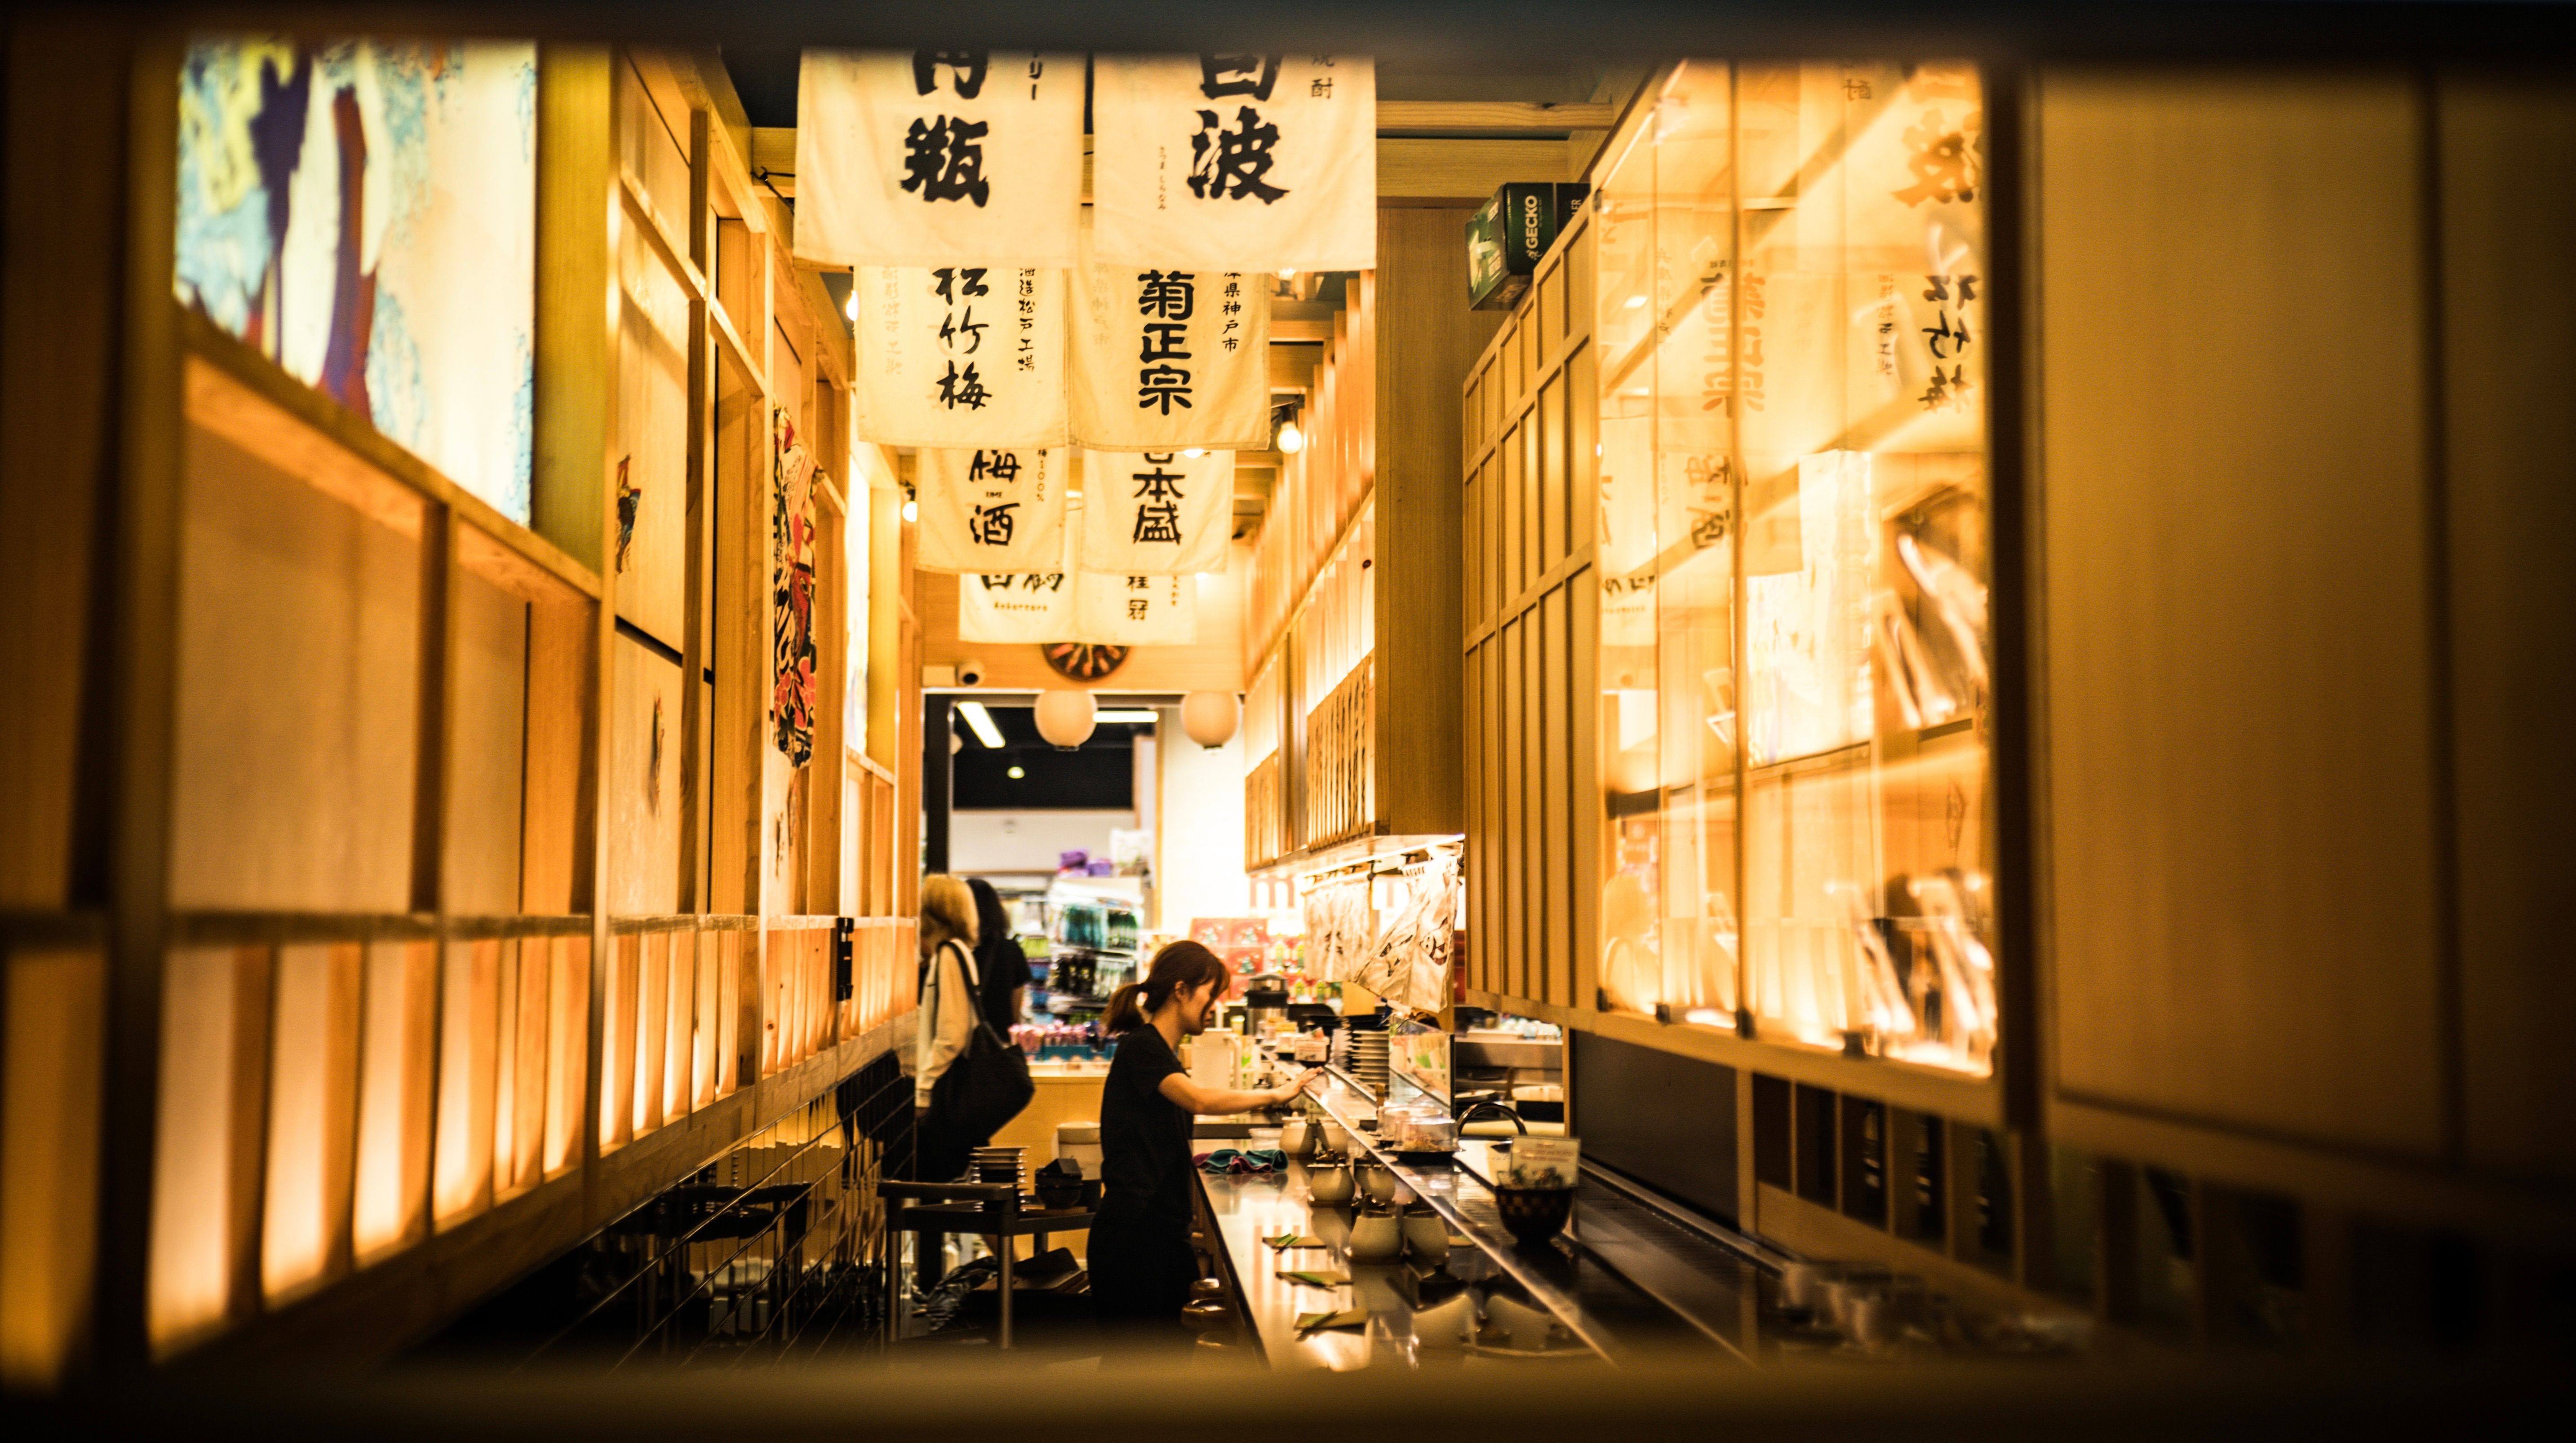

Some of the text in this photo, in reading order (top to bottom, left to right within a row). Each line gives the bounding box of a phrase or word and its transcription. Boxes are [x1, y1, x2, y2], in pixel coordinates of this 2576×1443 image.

[1029, 50, 1042, 101] リー
[1525, 195, 1539, 249] GECKO
[932, 268, 993, 411] 松竹梅
[1138, 270, 1195, 416] 菊正宗
